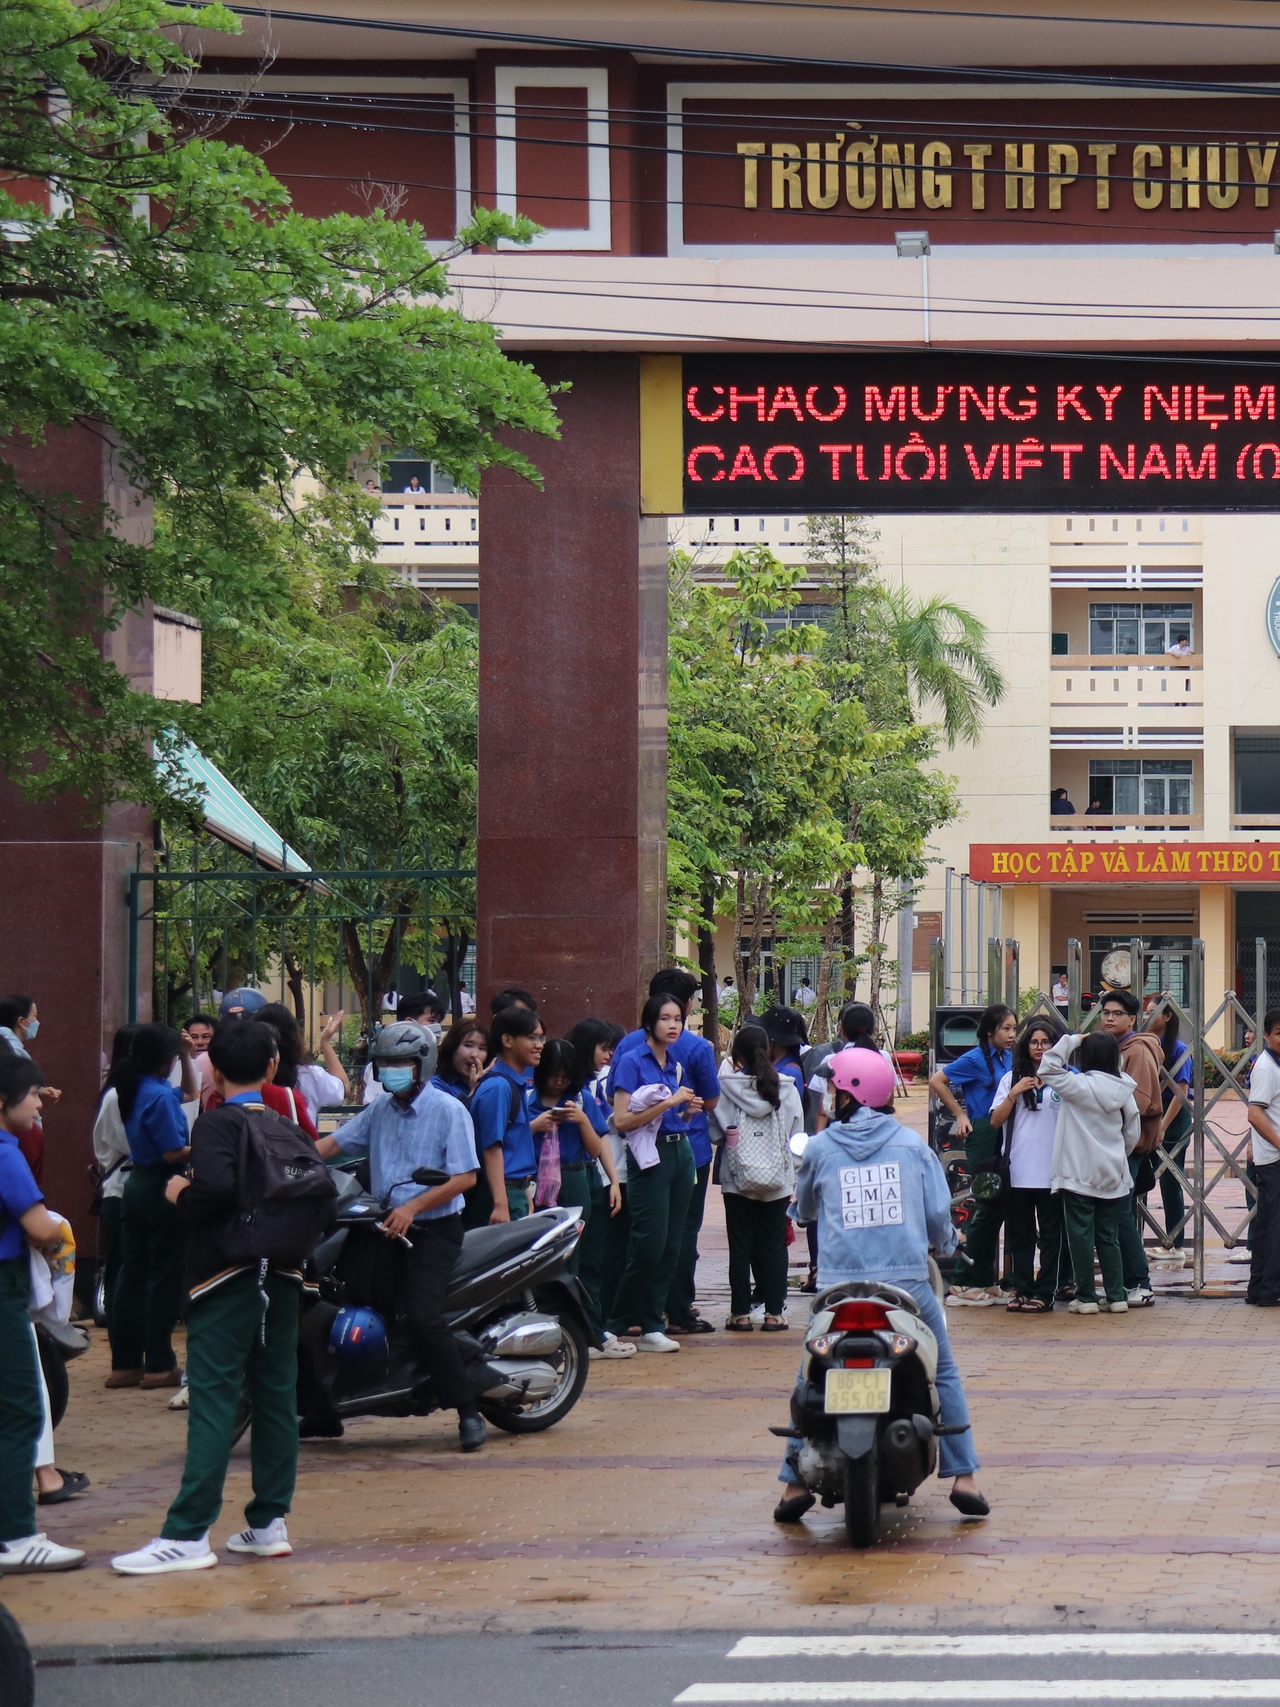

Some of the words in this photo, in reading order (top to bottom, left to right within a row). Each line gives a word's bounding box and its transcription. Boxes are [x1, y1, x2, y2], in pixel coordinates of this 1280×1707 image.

[736, 122, 953, 211] TRƯỜNG
[963, 142, 1117, 211] THPT
[686, 443, 805, 481] CAO
[1099, 443, 1217, 481] NAM
[991, 851, 1042, 879] HỌC
[1047, 846, 1096, 879] TẬP
[1102, 845, 1131, 873] VÀ
[1136, 845, 1192, 873] LÀM
[1196, 850, 1264, 873] THEO
